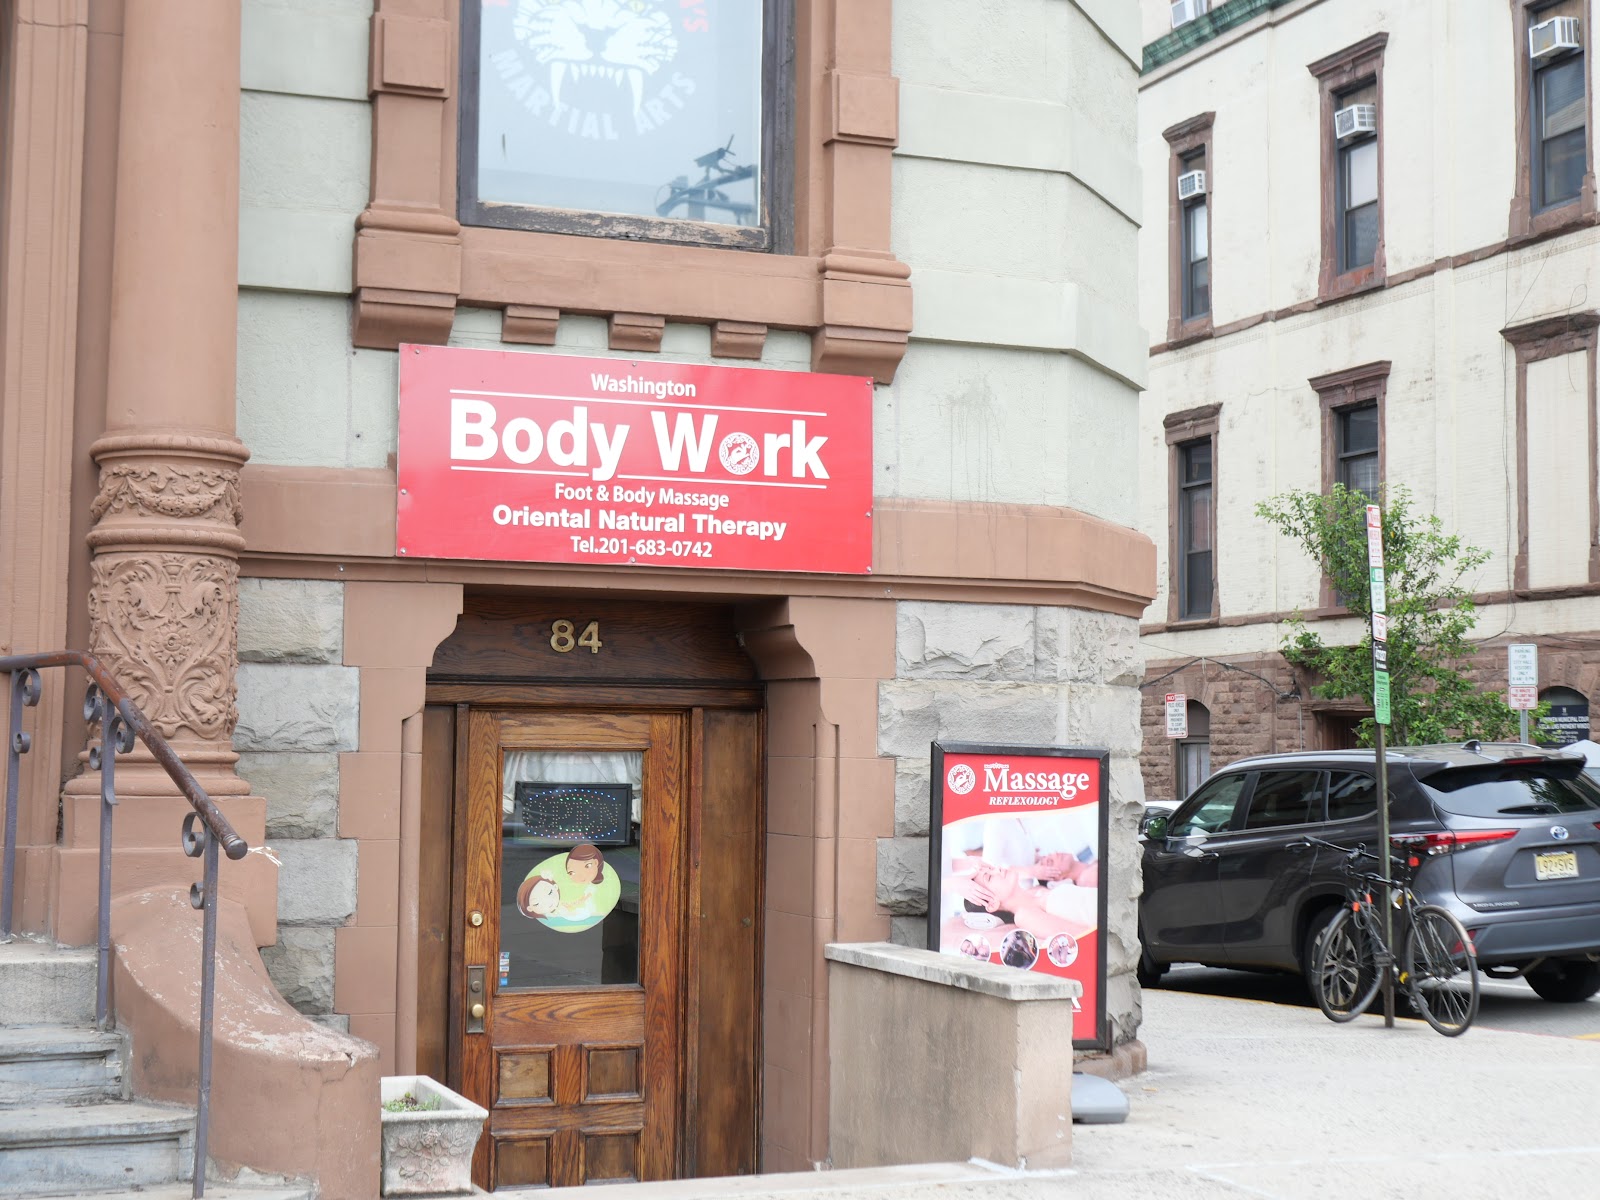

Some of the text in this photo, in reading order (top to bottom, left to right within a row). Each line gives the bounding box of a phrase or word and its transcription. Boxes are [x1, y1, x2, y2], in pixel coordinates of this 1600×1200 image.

[491, 48, 697, 140] MARTIAL ARTS
[590, 373, 697, 399] Washington
[450, 398, 631, 482] Body
[555, 482, 730, 510] Foot & Body Massage
[492, 503, 787, 541] Oriental Natural Therapy
[570, 535, 713, 559] Tel.201-683-0742
[549, 619, 603, 654] 84
[982, 765, 1090, 801] Massage
[521, 800, 622, 829] OPEN
[988, 795, 1060, 807] REFLEXOLOGY
